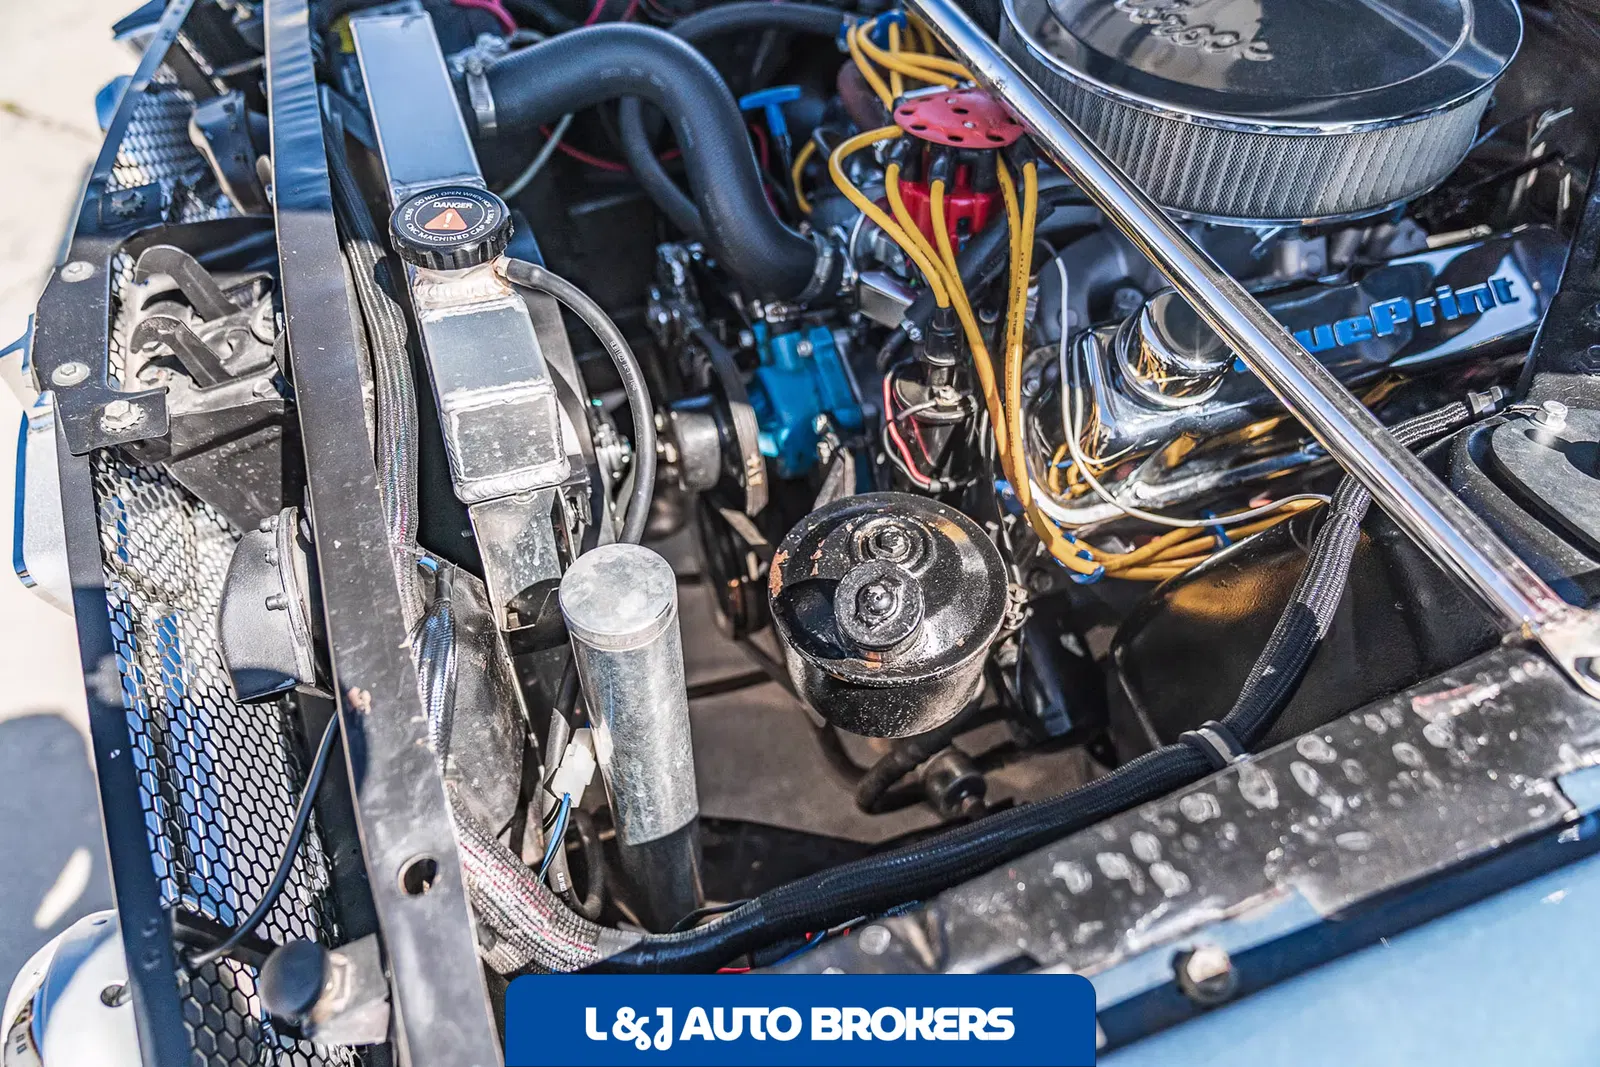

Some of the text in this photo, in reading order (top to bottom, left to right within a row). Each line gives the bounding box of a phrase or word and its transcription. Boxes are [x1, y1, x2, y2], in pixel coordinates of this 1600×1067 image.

[425, 193, 439, 201] NOT
[463, 191, 482, 201] WHEN
[433, 201, 473, 209] DANGER
[406, 222, 485, 242] CNC MACHINED CAP
[1233, 276, 1521, 373] uePrint
